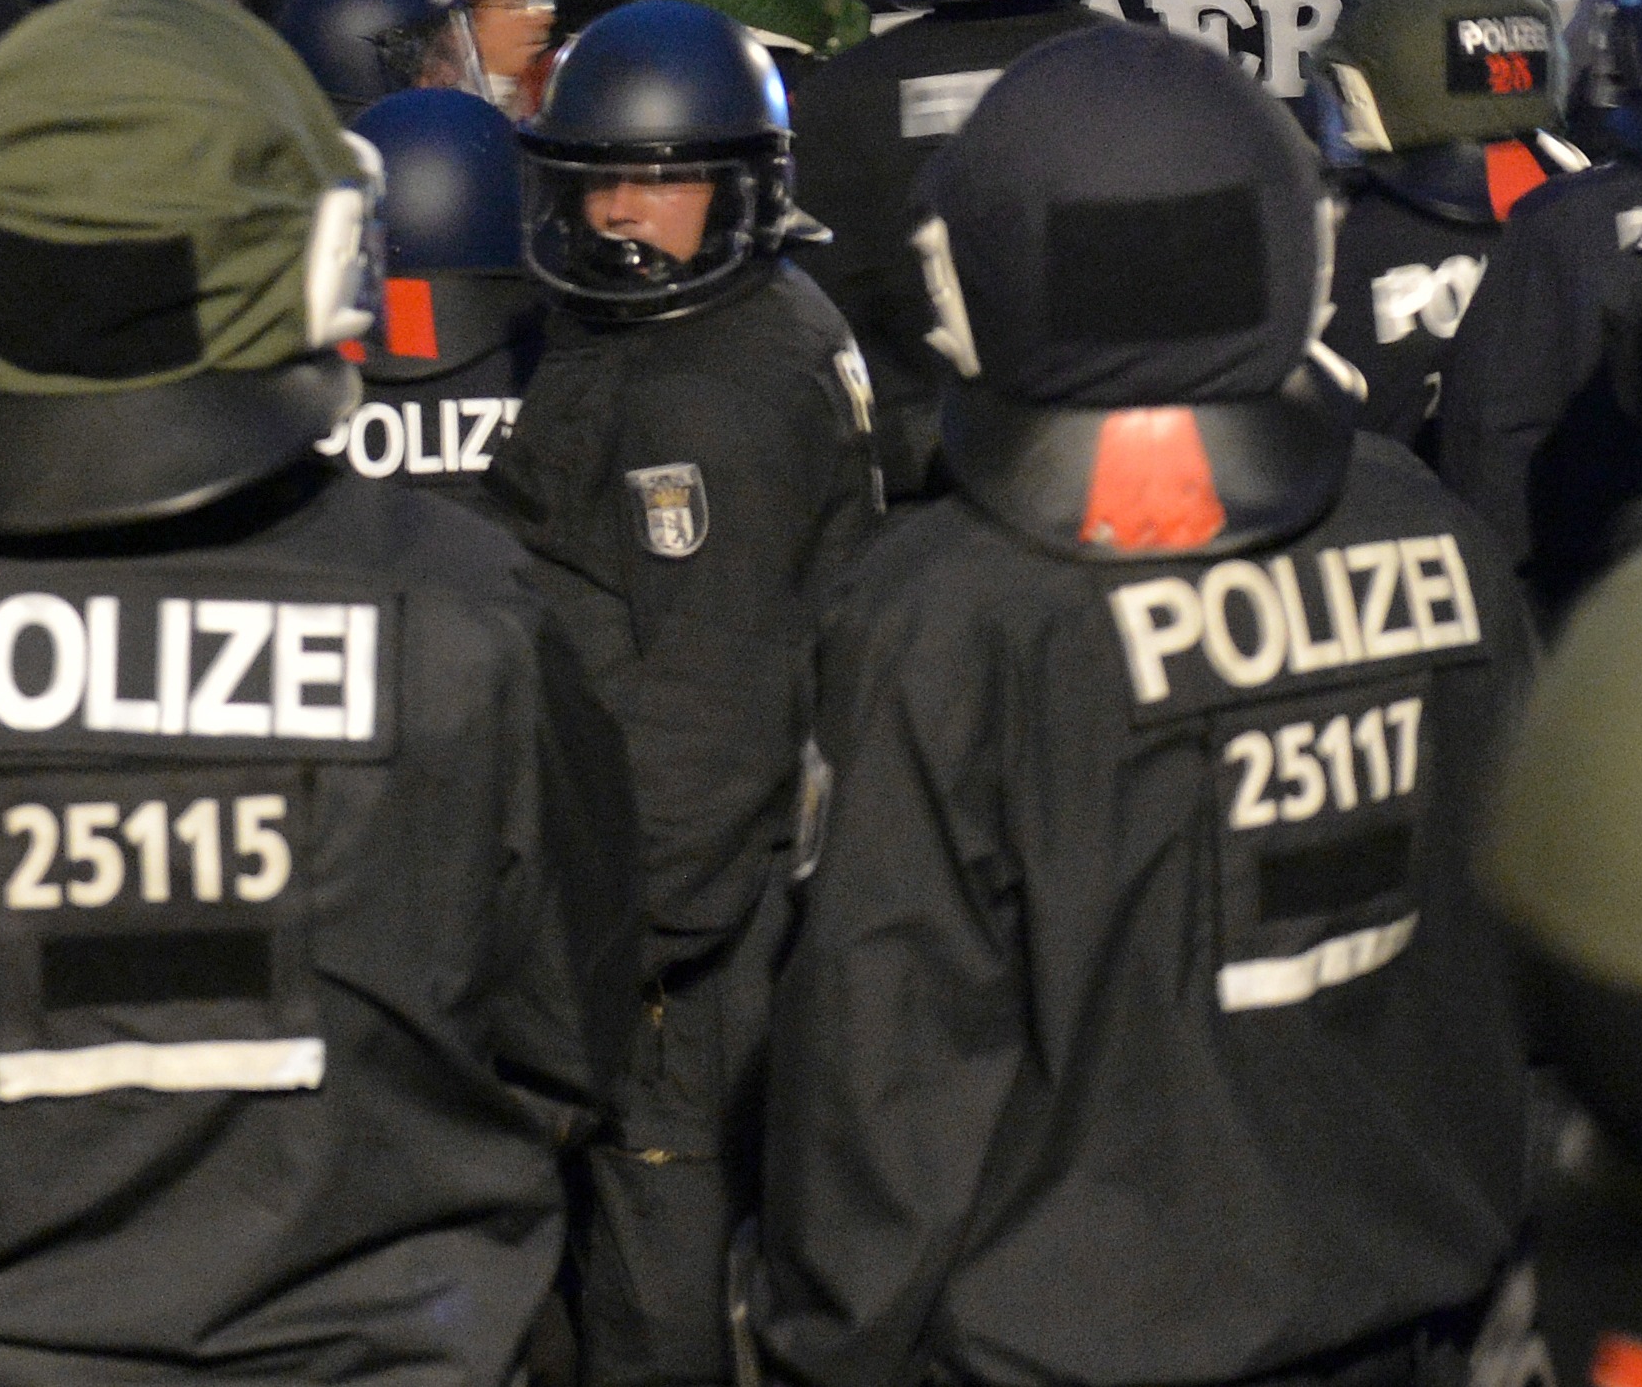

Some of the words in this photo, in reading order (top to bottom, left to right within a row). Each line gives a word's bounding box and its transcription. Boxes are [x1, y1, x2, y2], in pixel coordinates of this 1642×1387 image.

[313, 397, 523, 480] OLIZ
[1109, 533, 1481, 705] POLIZEI
[1223, 697, 1423, 832] 25117
[2, 793, 293, 910] 25115
